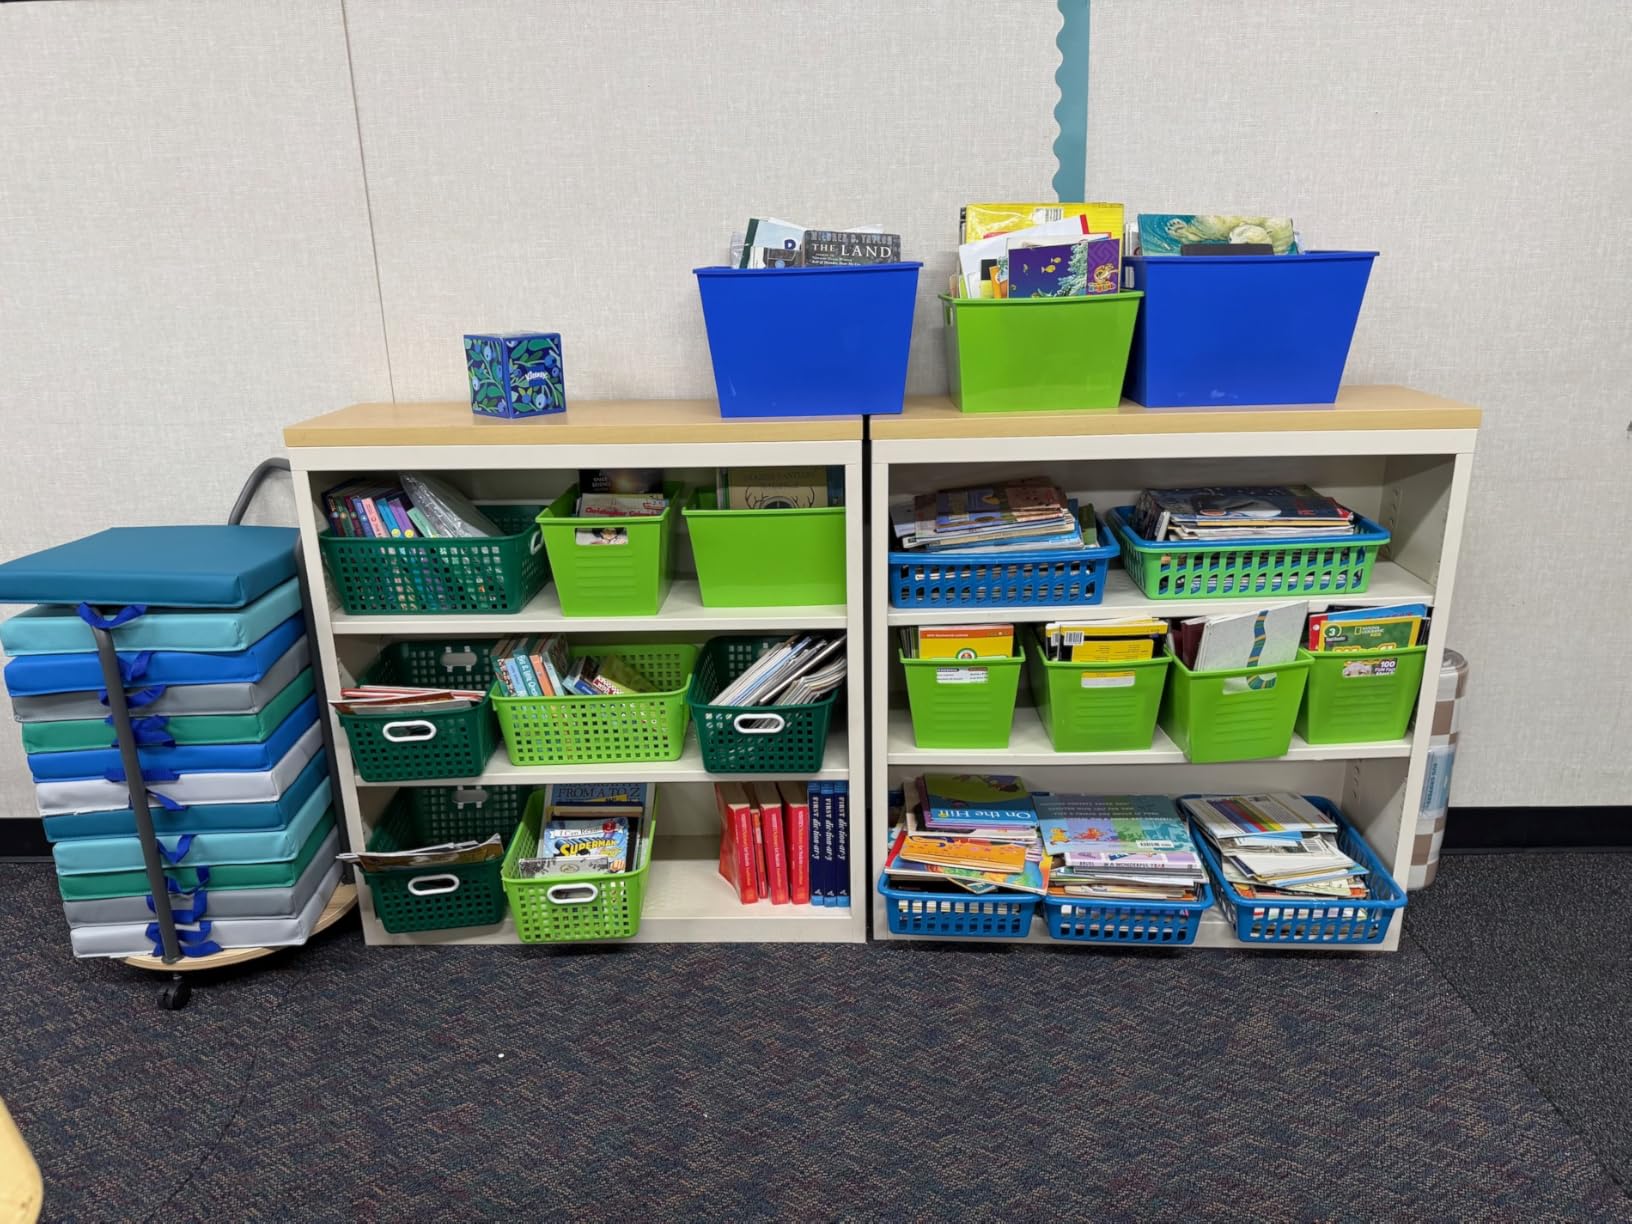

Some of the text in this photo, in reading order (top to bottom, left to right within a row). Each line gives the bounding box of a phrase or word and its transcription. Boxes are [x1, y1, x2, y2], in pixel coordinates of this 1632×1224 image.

[811, 243, 892, 258] THE LAND
[1328, 628, 1336, 637] 3
[1381, 660, 1395, 668] 100
[559, 787, 594, 798] FROM
[597, 787, 605, 798] A
[631, 787, 640, 798] Z
[975, 810, 1000, 818] the
[1006, 811, 1031, 819] On
[559, 839, 617, 857] SUPERMAN
